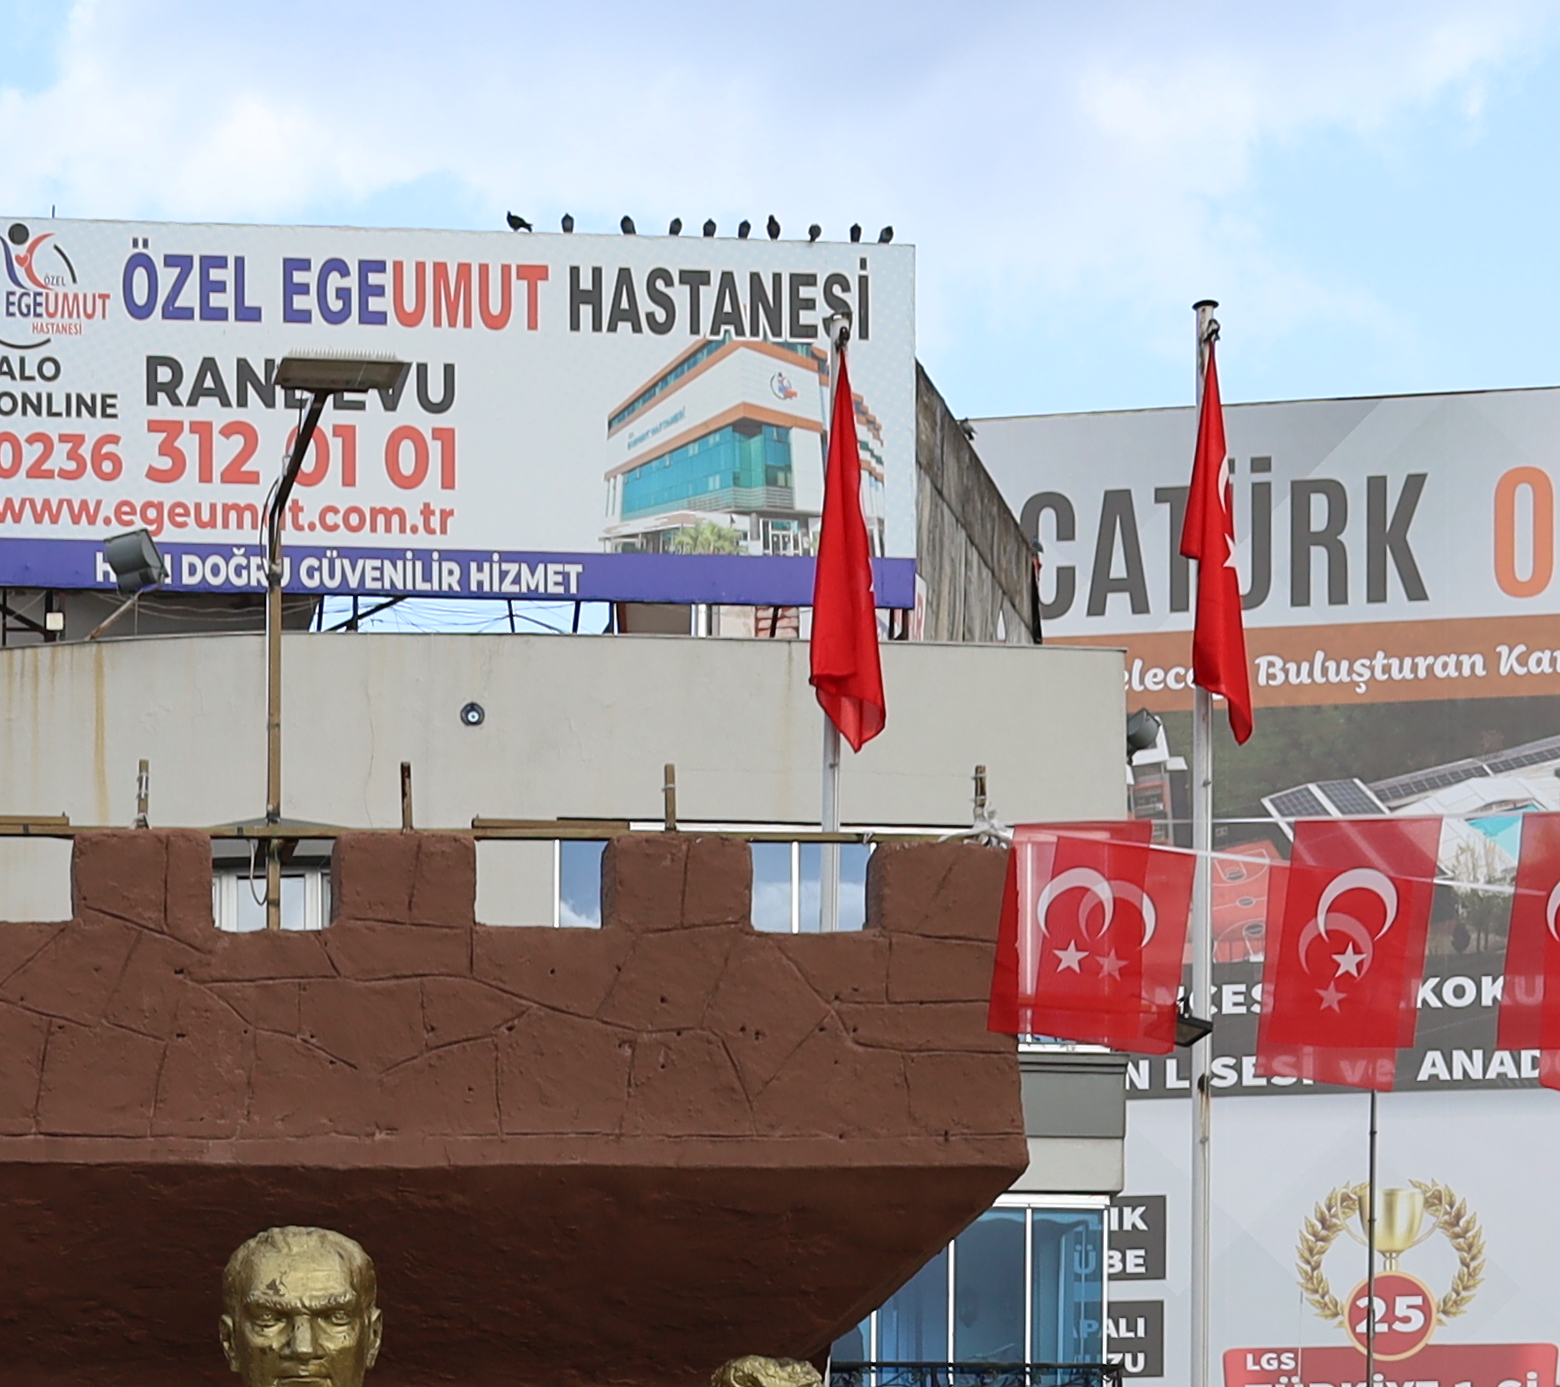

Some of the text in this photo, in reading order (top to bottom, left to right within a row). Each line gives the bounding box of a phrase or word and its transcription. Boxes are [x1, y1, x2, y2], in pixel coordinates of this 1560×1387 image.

[44, 274, 67, 287] ÖZEL
[123, 238, 870, 341] ÖZEL EGEUMUT HASTANESİ
[5, 290, 111, 320] EGEUMUT
[144, 419, 261, 485] 312
[286, 424, 357, 489] 01
[383, 425, 457, 491] 01
[299, 550, 461, 593] GÜVENİLİR
[469, 552, 584, 595] HİZMET
[1254, 649, 1487, 694] Buluşturan
[1354, 1295, 1426, 1333] 25
[1245, 1353, 1297, 1371] LGS
